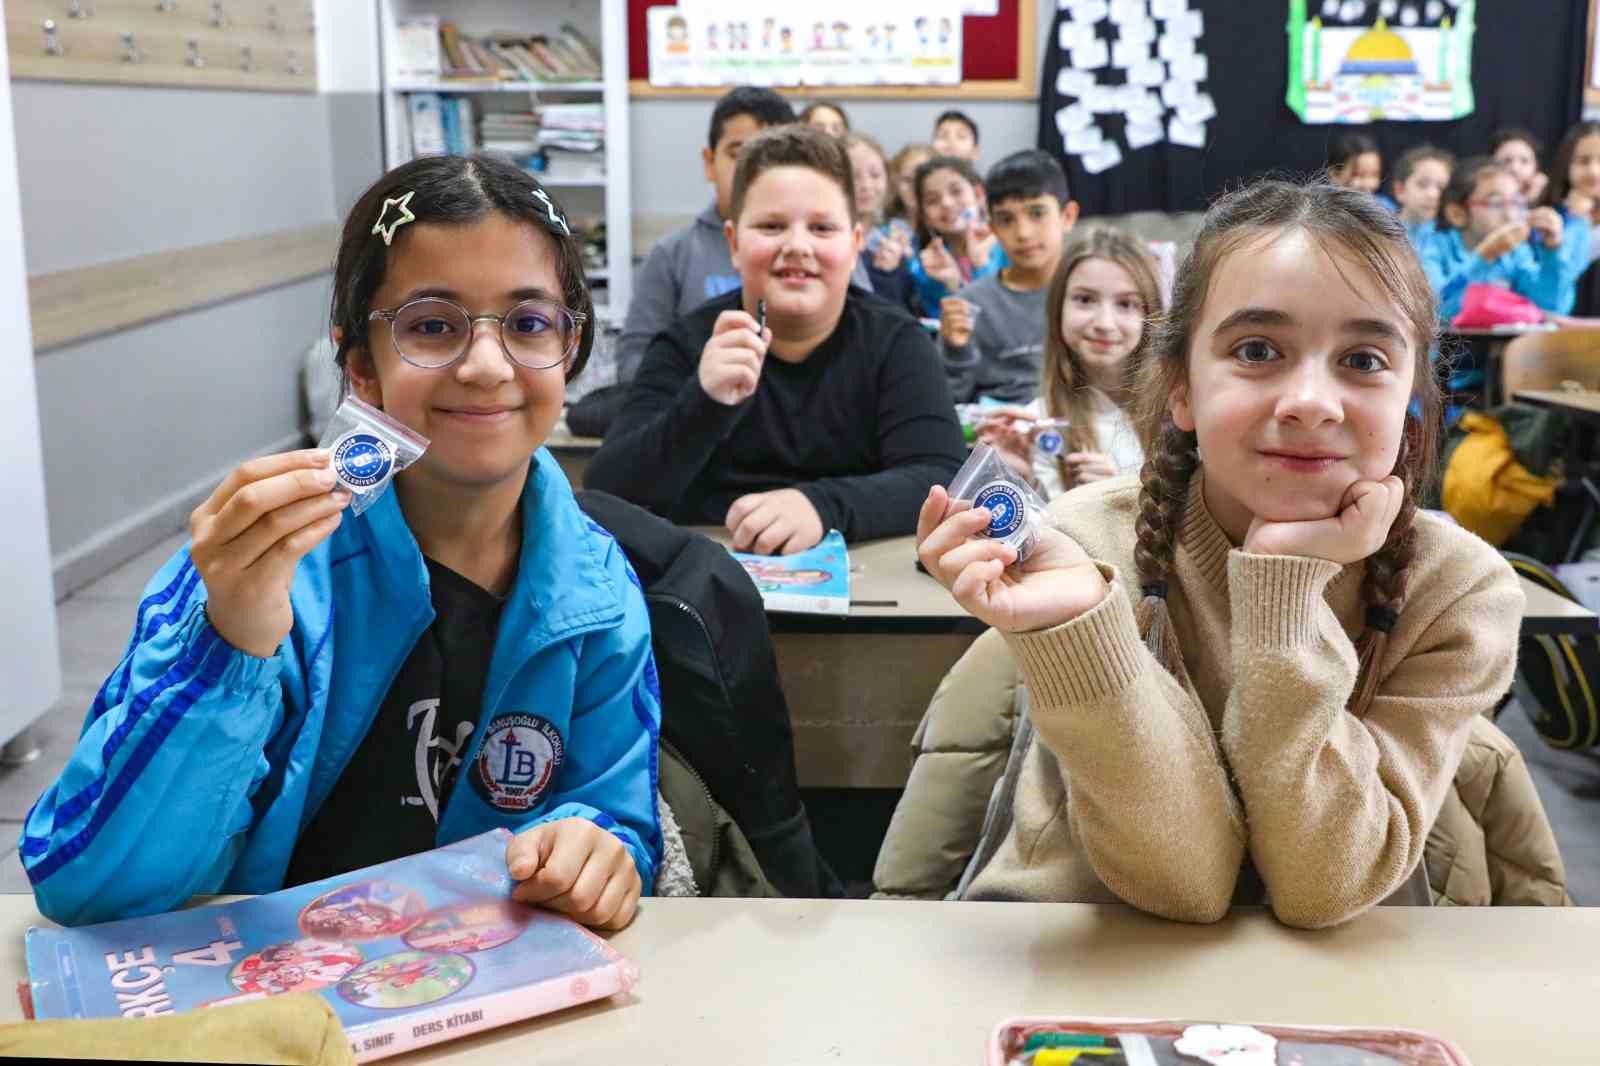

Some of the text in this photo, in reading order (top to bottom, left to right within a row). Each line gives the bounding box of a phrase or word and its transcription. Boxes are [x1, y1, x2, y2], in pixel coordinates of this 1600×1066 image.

[362, 1032, 395, 1051] SINIF
[412, 1019, 444, 1039] DERS
[446, 1008, 484, 1030] KİTABI
